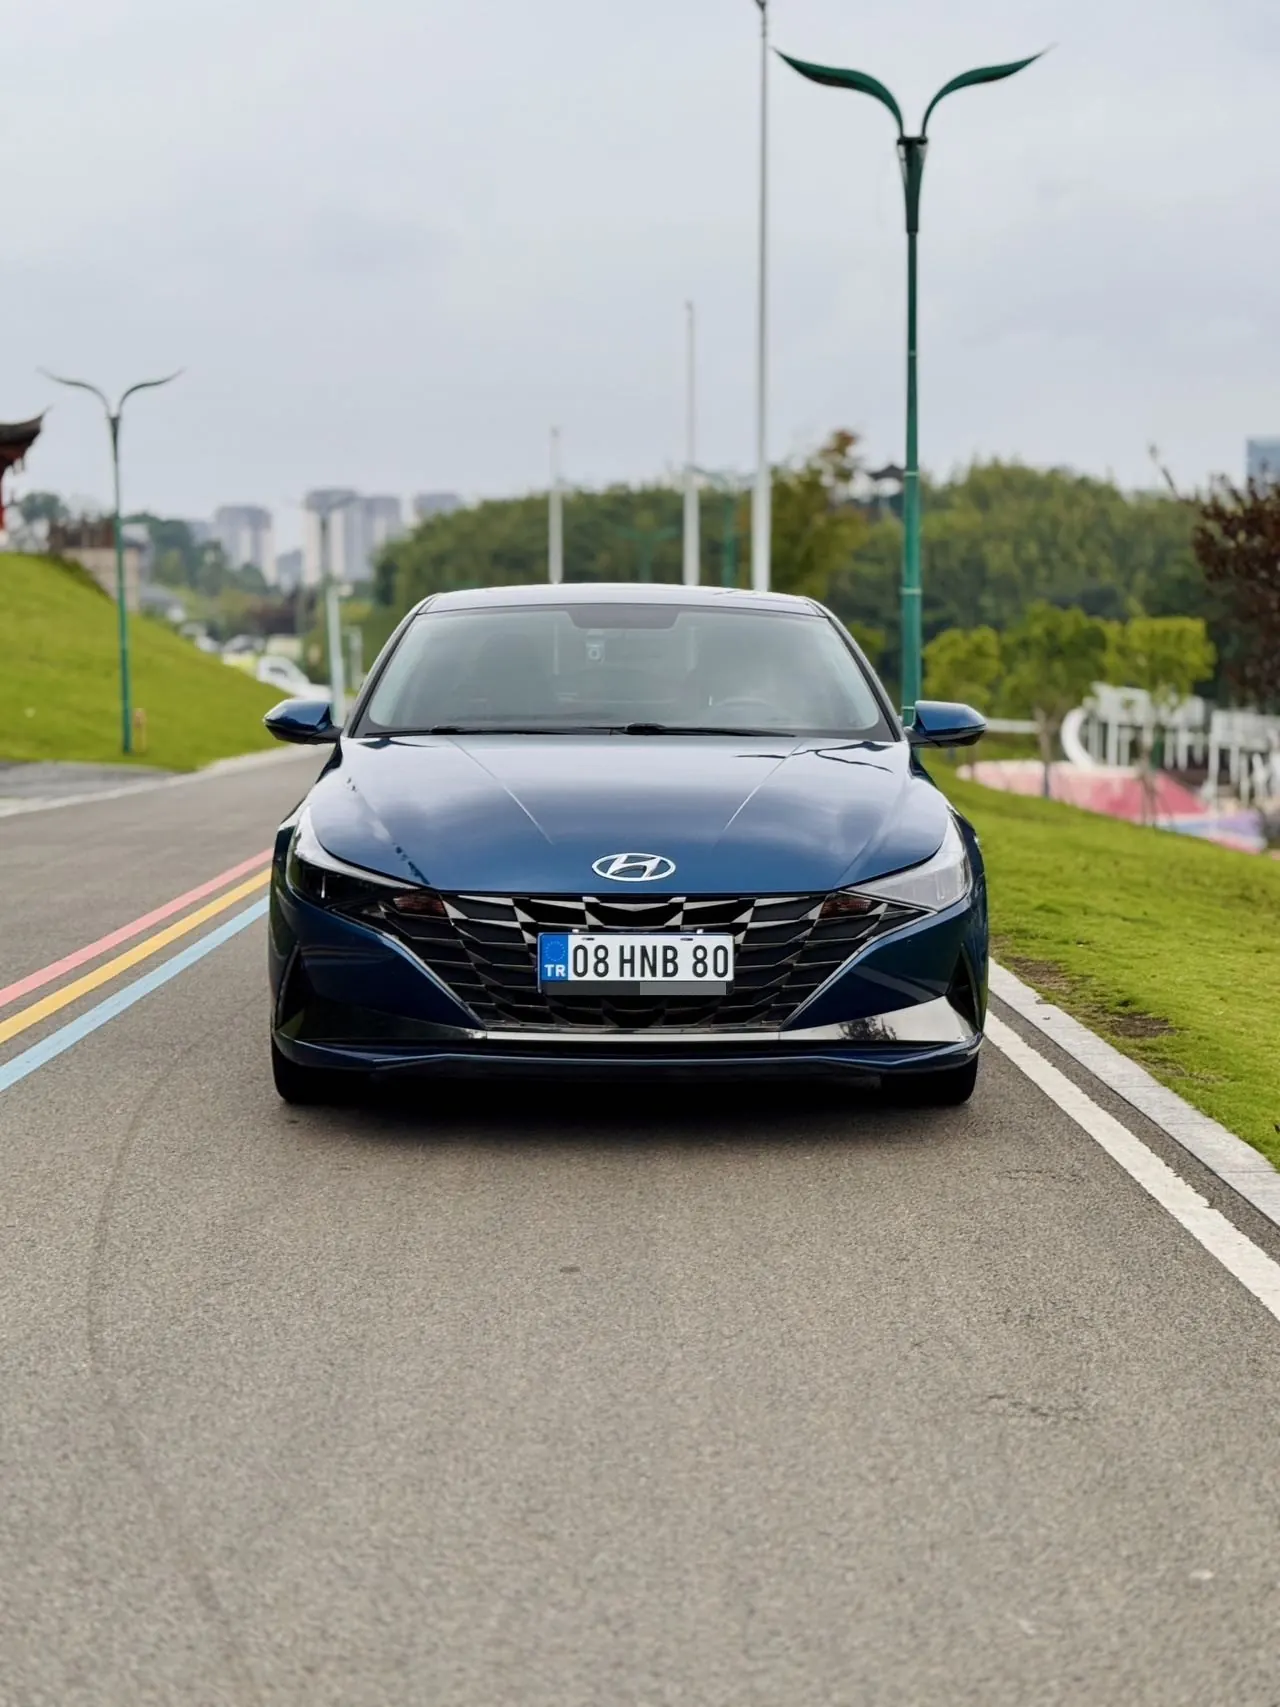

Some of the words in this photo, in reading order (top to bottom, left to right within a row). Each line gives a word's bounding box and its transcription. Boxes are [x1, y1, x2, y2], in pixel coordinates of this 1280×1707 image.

[544, 964, 566, 977] TR
[572, 944, 609, 977] 08
[619, 944, 679, 977] HNB
[692, 944, 729, 977] 80
